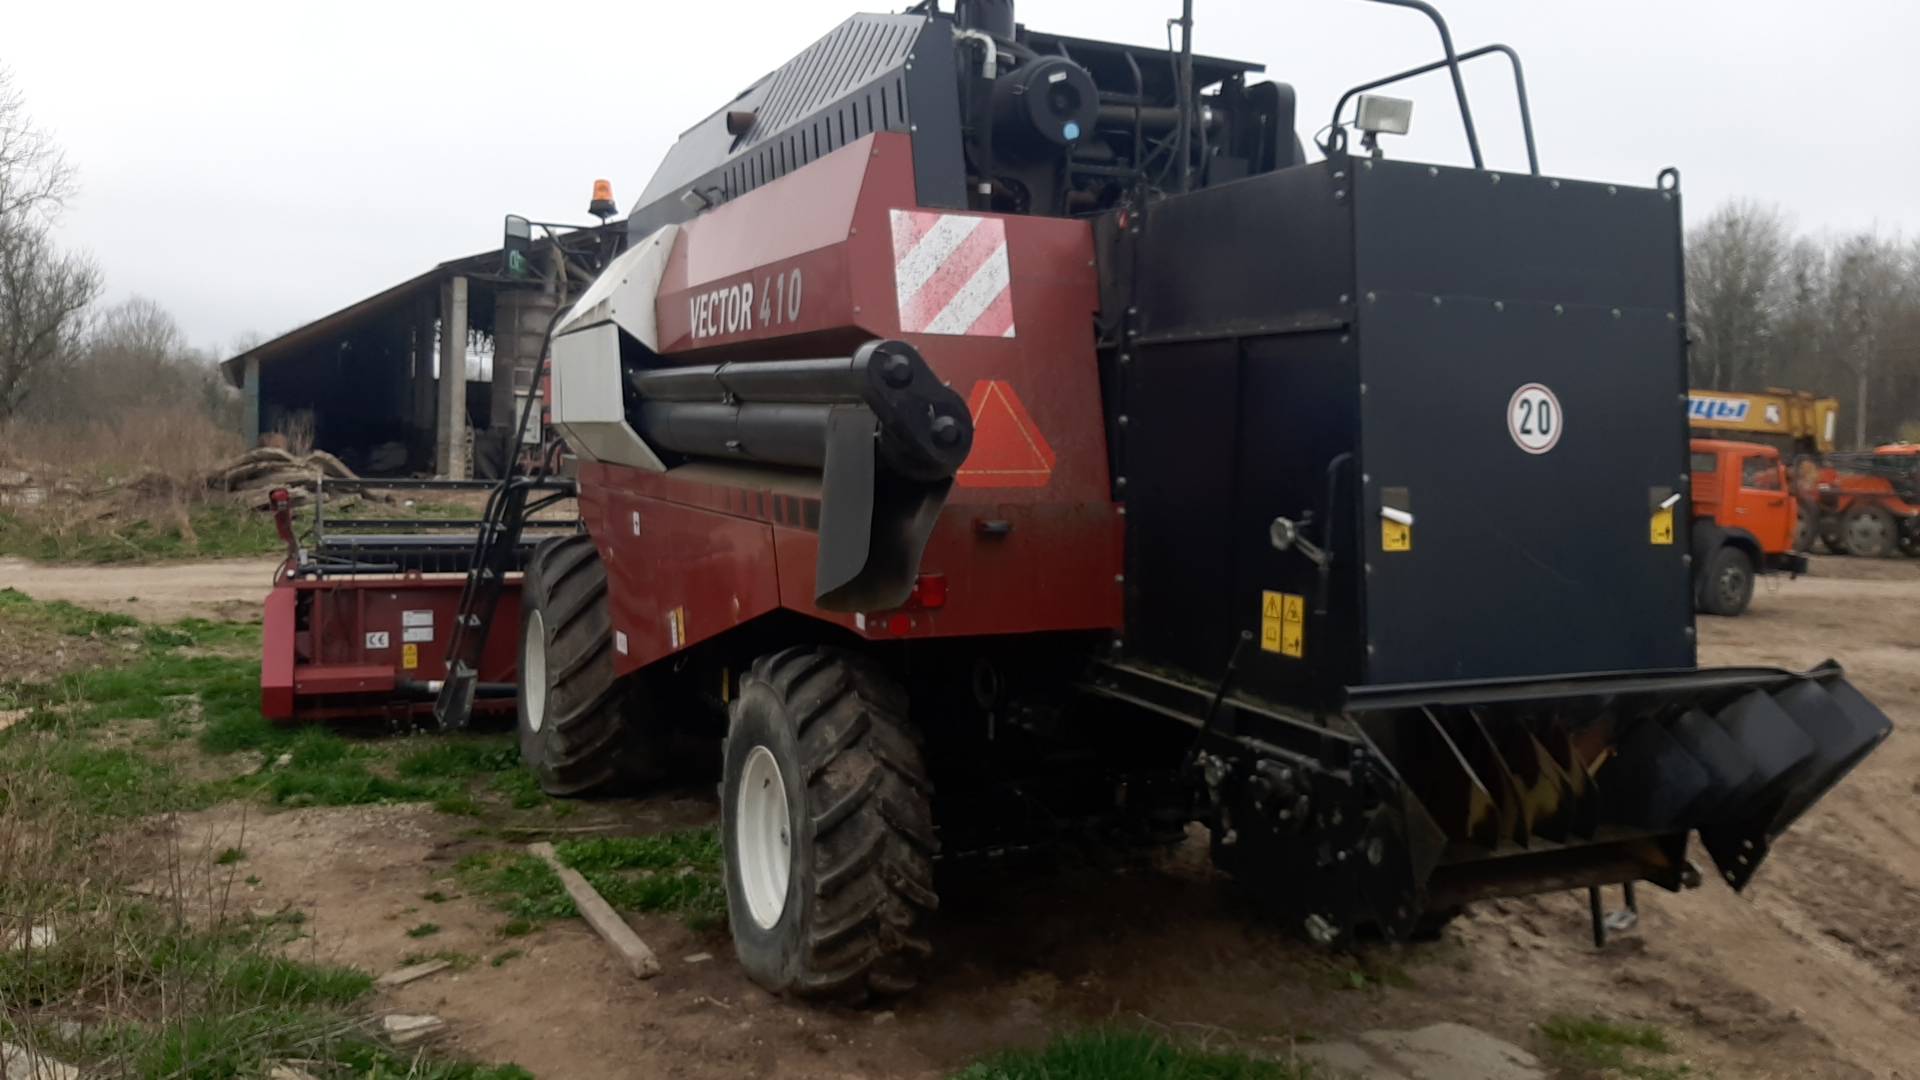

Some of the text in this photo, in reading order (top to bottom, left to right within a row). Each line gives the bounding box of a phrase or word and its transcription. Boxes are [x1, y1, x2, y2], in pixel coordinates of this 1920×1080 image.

[690, 268, 801, 339] VECTOR 410
[1519, 398, 1551, 436] 20
